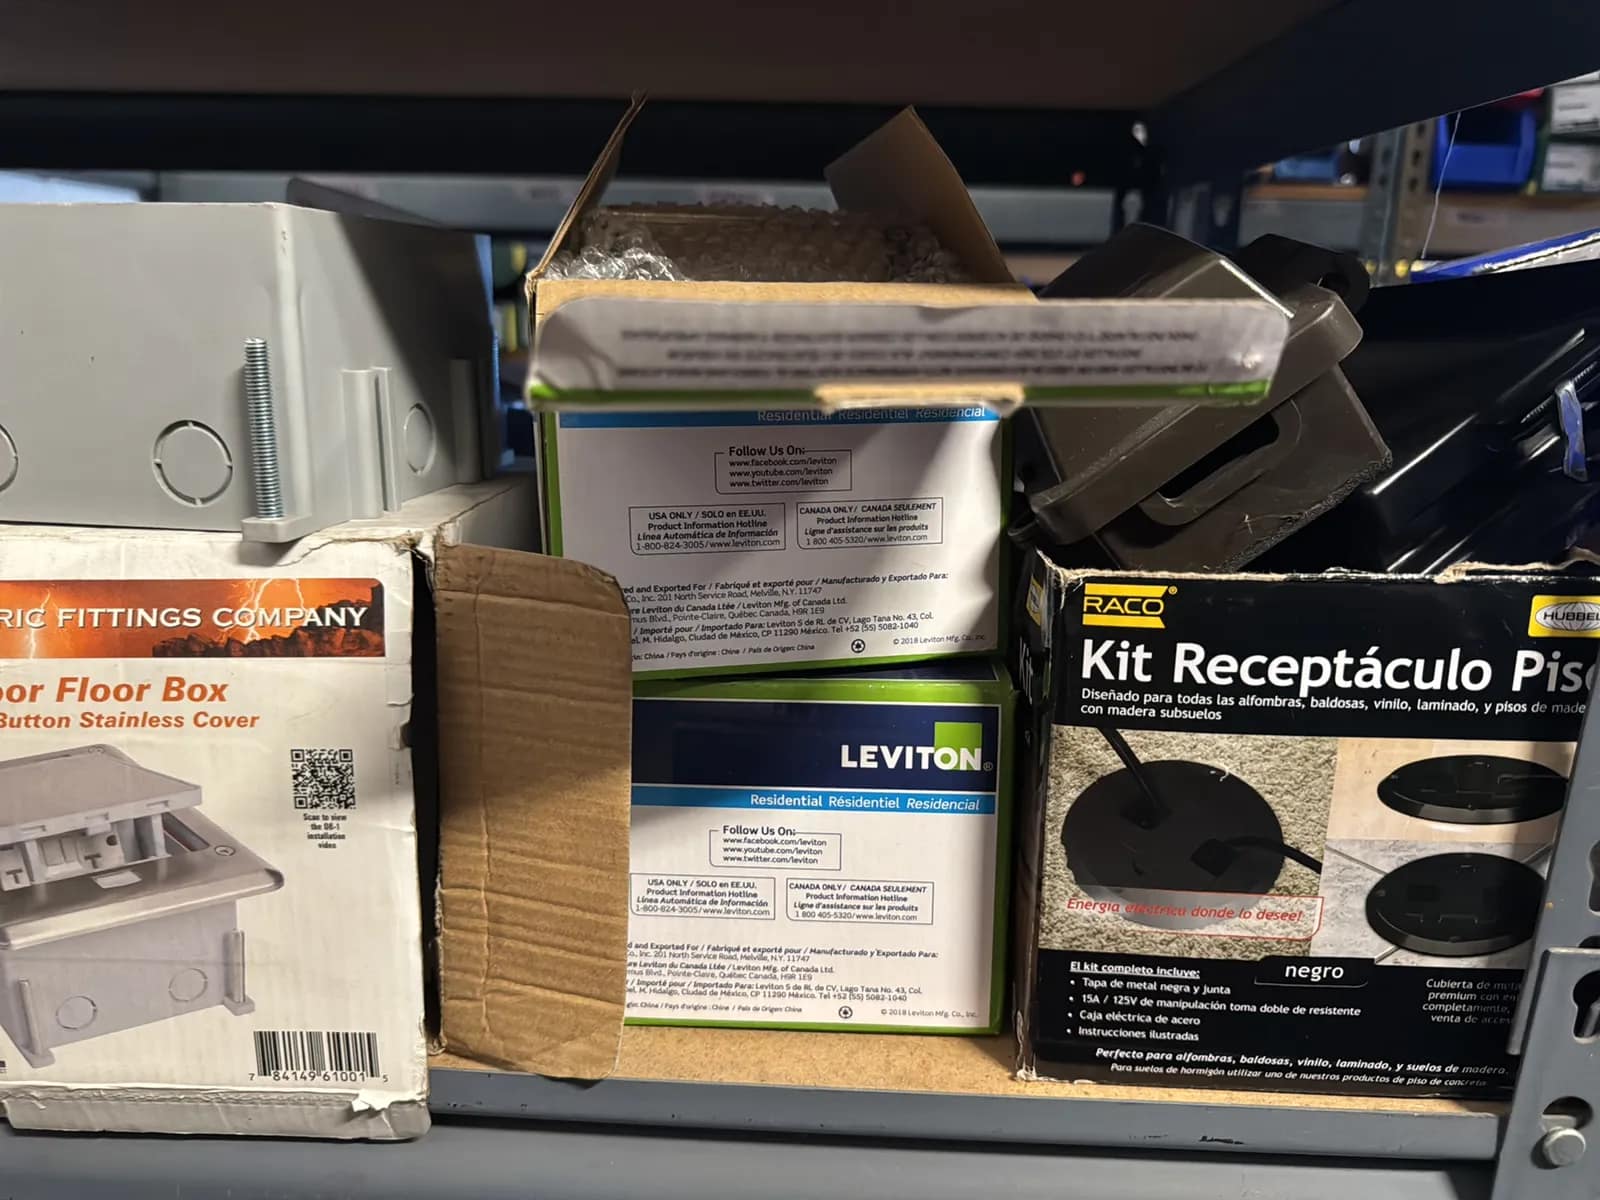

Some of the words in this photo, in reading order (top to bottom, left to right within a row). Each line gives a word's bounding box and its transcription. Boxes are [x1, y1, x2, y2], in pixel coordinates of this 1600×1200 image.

[728, 445, 766, 456] Follow
[768, 445, 784, 455] Us
[786, 445, 806, 455] On:
[647, 522, 681, 530] Product
[683, 520, 734, 529] Information
[1083, 597, 1164, 614] RACO
[58, 607, 201, 628] FITTINGS
[212, 606, 368, 628] COMPANY
[1082, 638, 1152, 682] Kit
[1173, 642, 1492, 698] Receptáculo
[0, 684, 44, 704] or
[56, 676, 152, 702] Floor
[162, 676, 229, 702] Box
[1081, 687, 1139, 701] Diseñado
[1143, 693, 1172, 704] para
[1177, 692, 1212, 704] todas
[1216, 693, 1234, 705] las
[1238, 693, 1308, 708] alfombras,
[1310, 696, 1368, 710] baldosas,
[1373, 697, 1411, 711] vinilo,
[1416, 698, 1478, 713] laminado,
[1483, 702, 1492, 714] y
[1494, 700, 1526, 714] pisos
[1530, 701, 1547, 712] de
[80, 711, 185, 728] Stainless
[193, 711, 260, 728] Cover
[1080, 704, 1103, 714] con
[1107, 704, 1155, 716] madera
[1160, 706, 1221, 720] subsuelos
[840, 744, 982, 771] LEVITON
[750, 794, 822, 809] Residential
[828, 795, 899, 808] Résidentiel
[906, 797, 979, 809] Residencial
[722, 825, 758, 834] Follow
[761, 826, 775, 835] Us
[777, 826, 797, 835] On:
[722, 837, 826, 845] www.facebook.com/leviton
[1190, 904, 1234, 918] donde
[1239, 907, 1251, 919] lo
[1256, 909, 1304, 922] desee!
[1070, 961, 1080, 970] El
[1084, 962, 1098, 971] kit
[1101, 964, 1153, 974] completo
[1156, 966, 1199, 976] incluye:
[1284, 965, 1344, 982] negro
[1082, 977, 1106, 988] Tapa
[1110, 978, 1123, 988] de
[1126, 981, 1156, 990] metal
[1160, 983, 1190, 993] negra
[1193, 985, 1199, 994] y
[1202, 984, 1230, 994] junta
[1425, 978, 1473, 989] Cubierta
[1082, 993, 1099, 1003] 15A
[1113, 995, 1137, 1005] 125V
[1139, 997, 1153, 1006] de
[1156, 999, 1226, 1010] manipulación
[1229, 1002, 1256, 1011] toma
[1259, 1003, 1289, 1013] doble
[1292, 1005, 1306, 1014] de
[1308, 1006, 1360, 1015] resistente
[1427, 991, 1476, 1001] premium
[1079, 1009, 1102, 1021] Caja
[1105, 1011, 1151, 1022] eléctrica
[1154, 1014, 1168, 1023] de
[1170, 1016, 1200, 1024] acero
[1430, 1014, 1460, 1022] venta
[1078, 1026, 1146, 1038] Instrucciones
[1149, 1030, 1198, 1040] ilustradas
[1095, 1047, 1143, 1059] Perfecto
[1145, 1052, 1172, 1060] para
[1175, 1052, 1235, 1064] alfombras,
[1239, 1054, 1292, 1066] baldosas,
[1297, 1057, 1331, 1068] vinilo,
[1335, 1058, 1392, 1071] laminado,
[1394, 1063, 1403, 1072] y
[1406, 1062, 1441, 1072] suelos
[1444, 1063, 1459, 1072] de
[272, 1071, 316, 1081] 84149
[322, 1072, 366, 1082] 61001
[383, 1074, 388, 1082] 5
